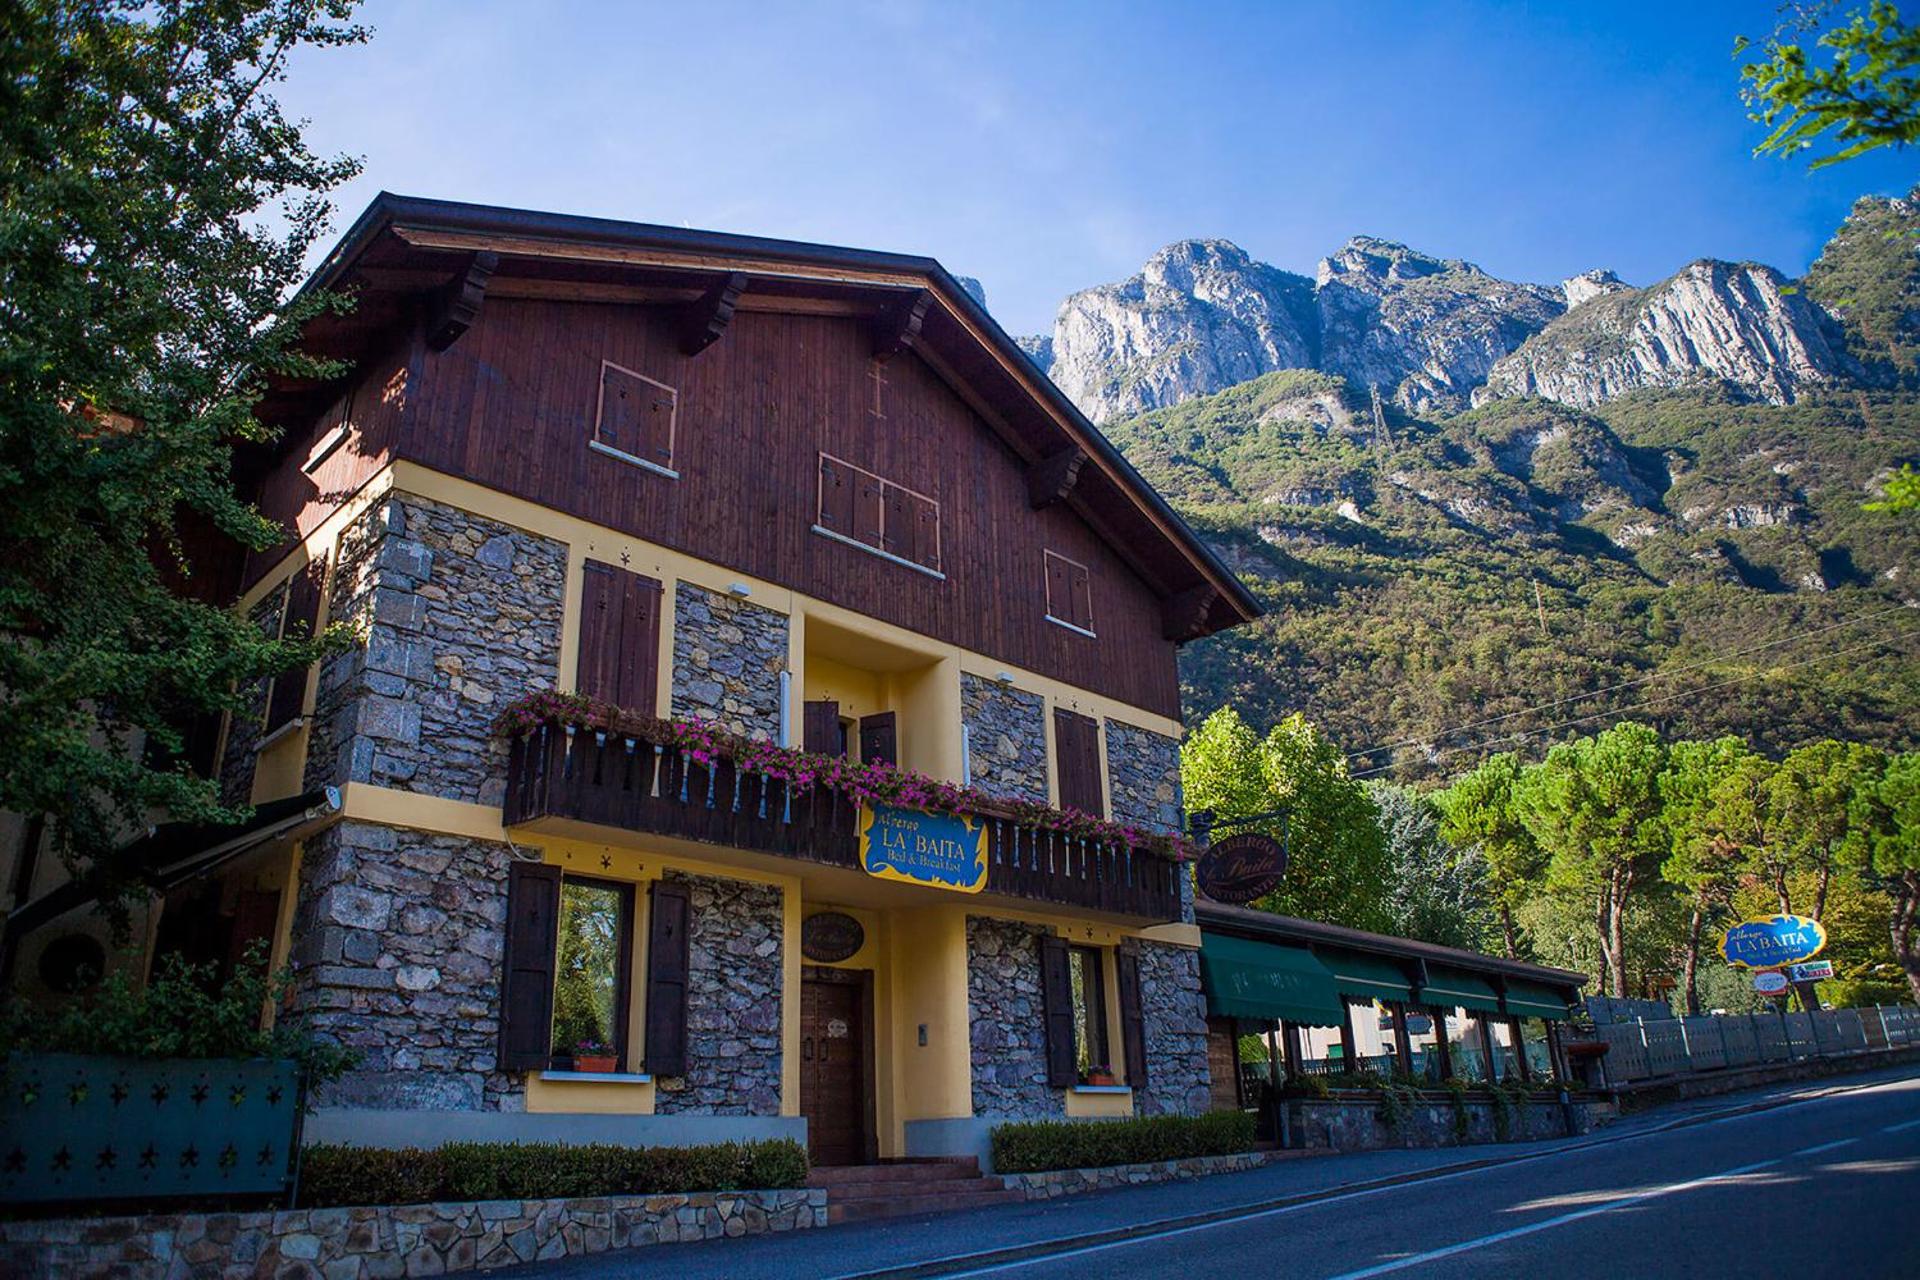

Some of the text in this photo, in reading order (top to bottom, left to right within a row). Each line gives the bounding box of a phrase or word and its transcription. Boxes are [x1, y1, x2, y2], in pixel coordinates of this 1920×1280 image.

[882, 828, 965, 861] LA BAITA
[887, 848, 961, 873] Bed & Breakfast
[1736, 940, 1757, 953] LA
[1759, 932, 1809, 950] BAITA
